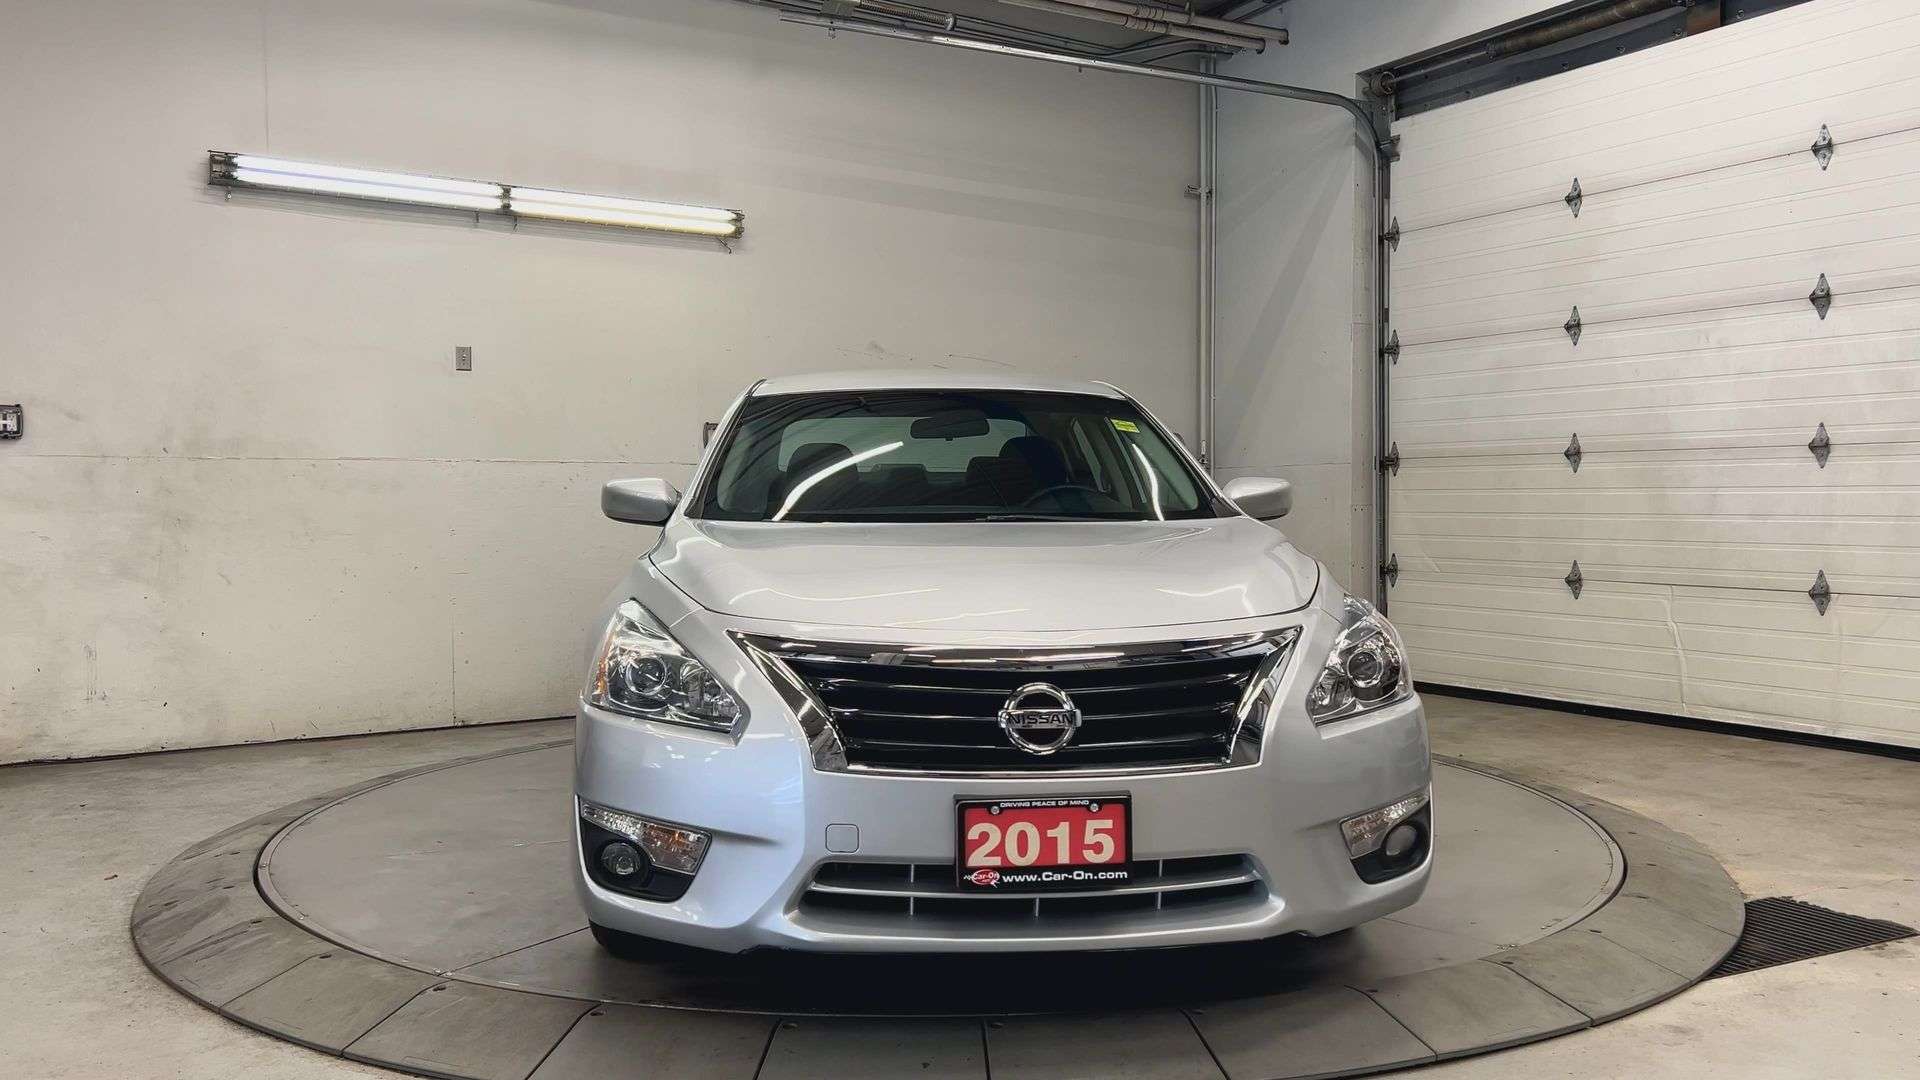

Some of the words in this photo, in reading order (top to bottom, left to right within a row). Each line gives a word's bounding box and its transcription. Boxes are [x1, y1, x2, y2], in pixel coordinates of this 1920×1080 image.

[1006, 711, 1073, 725] NISSAN
[967, 819, 1115, 867] 2015
[1002, 870, 1128, 882] www.Car-On.com
